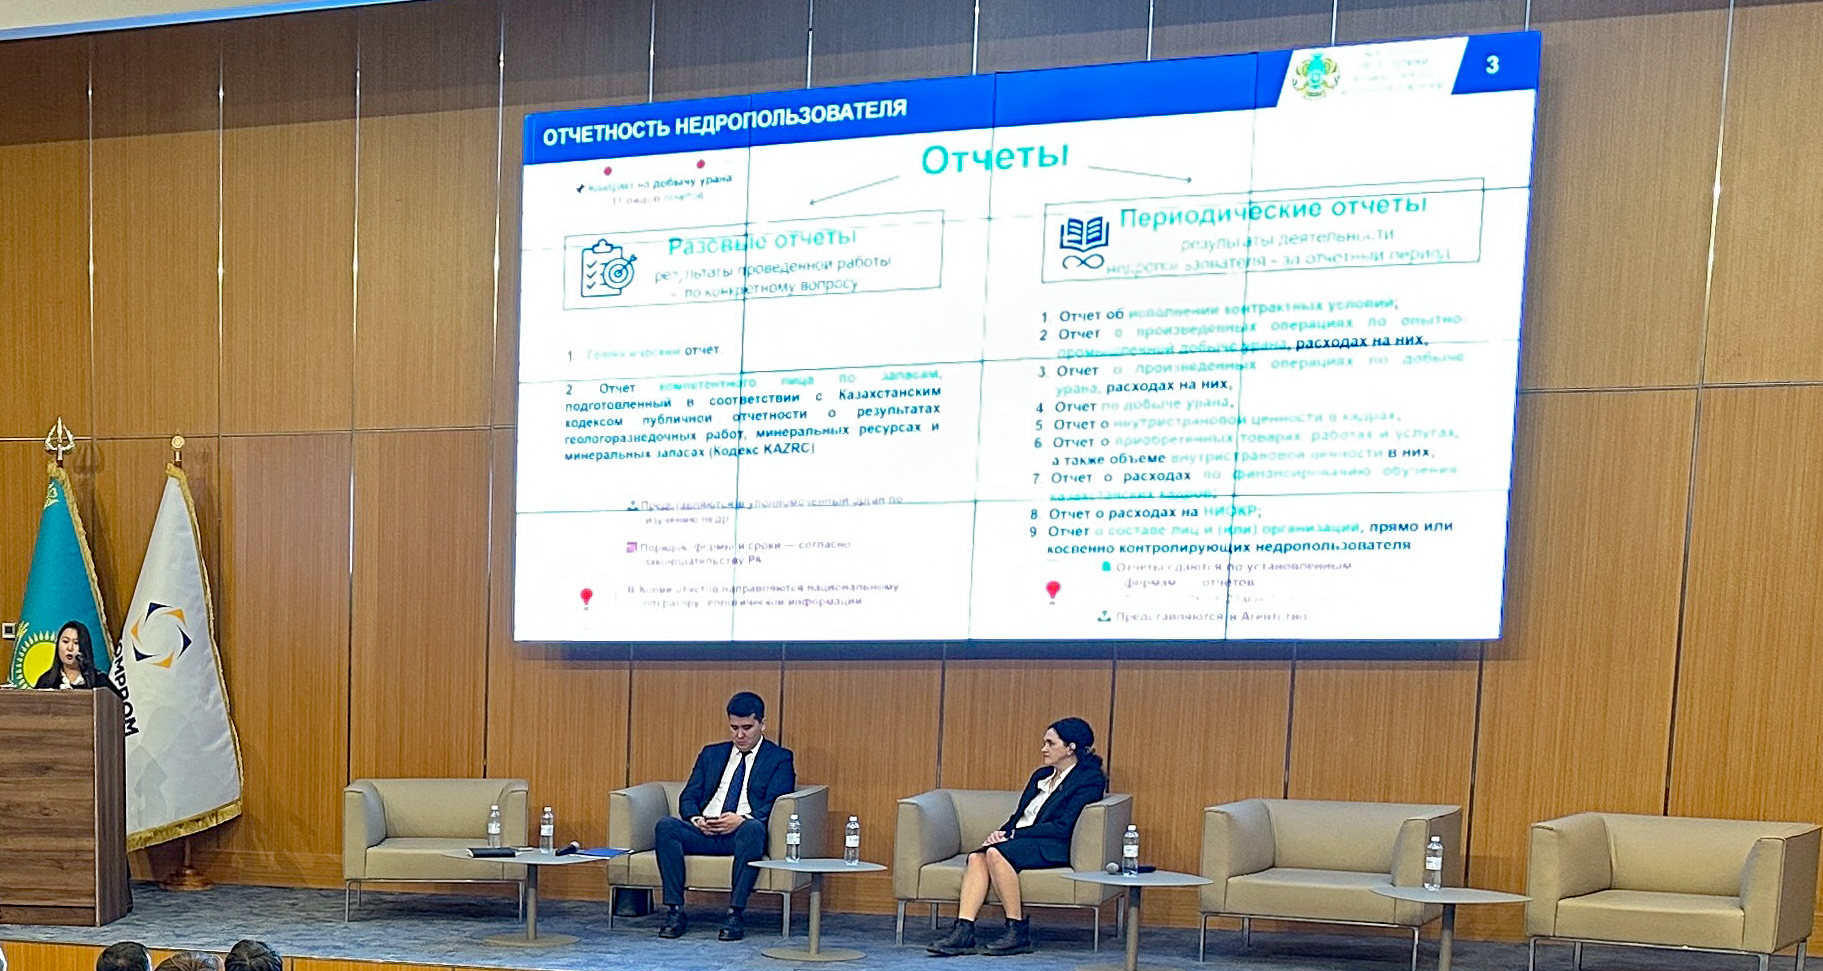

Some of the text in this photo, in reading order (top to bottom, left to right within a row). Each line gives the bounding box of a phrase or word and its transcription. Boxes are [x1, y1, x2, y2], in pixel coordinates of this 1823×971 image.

[1485, 55, 1499, 75] 3
[542, 98, 908, 146] ОТЧЕТНОСТЬ НЕДРОПОЛЬЗОВАТЕЛЯ
[922, 144, 1069, 175] Отчеты
[1120, 197, 1427, 232] Периодические отчеты
[668, 229, 857, 256] Разовые отчеты
[837, 256, 891, 272] работы
[801, 278, 858, 293] вопросу
[1059, 310, 1101, 323] Отчет
[1106, 308, 1124, 320] об
[1058, 328, 1100, 340] Отчет
[1296, 335, 1367, 352] расходах
[1372, 334, 1391, 347] на
[1057, 365, 1099, 377] Отчет
[599, 382, 636, 395] Отчет
[1106, 380, 1174, 396] расходах
[1179, 380, 1197, 392] на
[565, 396, 672, 413] подготовленный
[709, 393, 801, 407] соответствии
[839, 387, 942, 402] Казахстанским
[1055, 401, 1097, 414] Отчет
[565, 417, 623, 429] кодексом
[732, 409, 808, 423] отчетности
[857, 403, 941, 420] результатах
[1054, 418, 1095, 431] Отчет
[1100, 419, 1110, 430] о
[564, 431, 697, 446] геологоразведочных
[756, 425, 850, 441] минеральных
[859, 422, 922, 438] ресурсах
[931, 422, 940, 432] и
[1053, 436, 1094, 448] Отчет
[1100, 437, 1110, 447] о
[564, 448, 651, 463] минеральных
[1052, 456, 1060, 467] а
[1064, 454, 1104, 466] также
[1110, 451, 1166, 465] объеме
[1388, 448, 1397, 459] в
[1051, 472, 1092, 484] Отчет
[1104, 472, 1113, 482] о
[1123, 470, 1191, 484] расходах
[1049, 507, 1090, 520] Отчет
[1095, 508, 1104, 519] о
[1108, 506, 1177, 521] расходах
[1181, 506, 1199, 518] на
[1048, 525, 1089, 537] Отчет
[1369, 521, 1419, 534] прямо
[1424, 521, 1454, 532] или
[1047, 540, 1412, 556] косвенно контролирующих недропользователя
